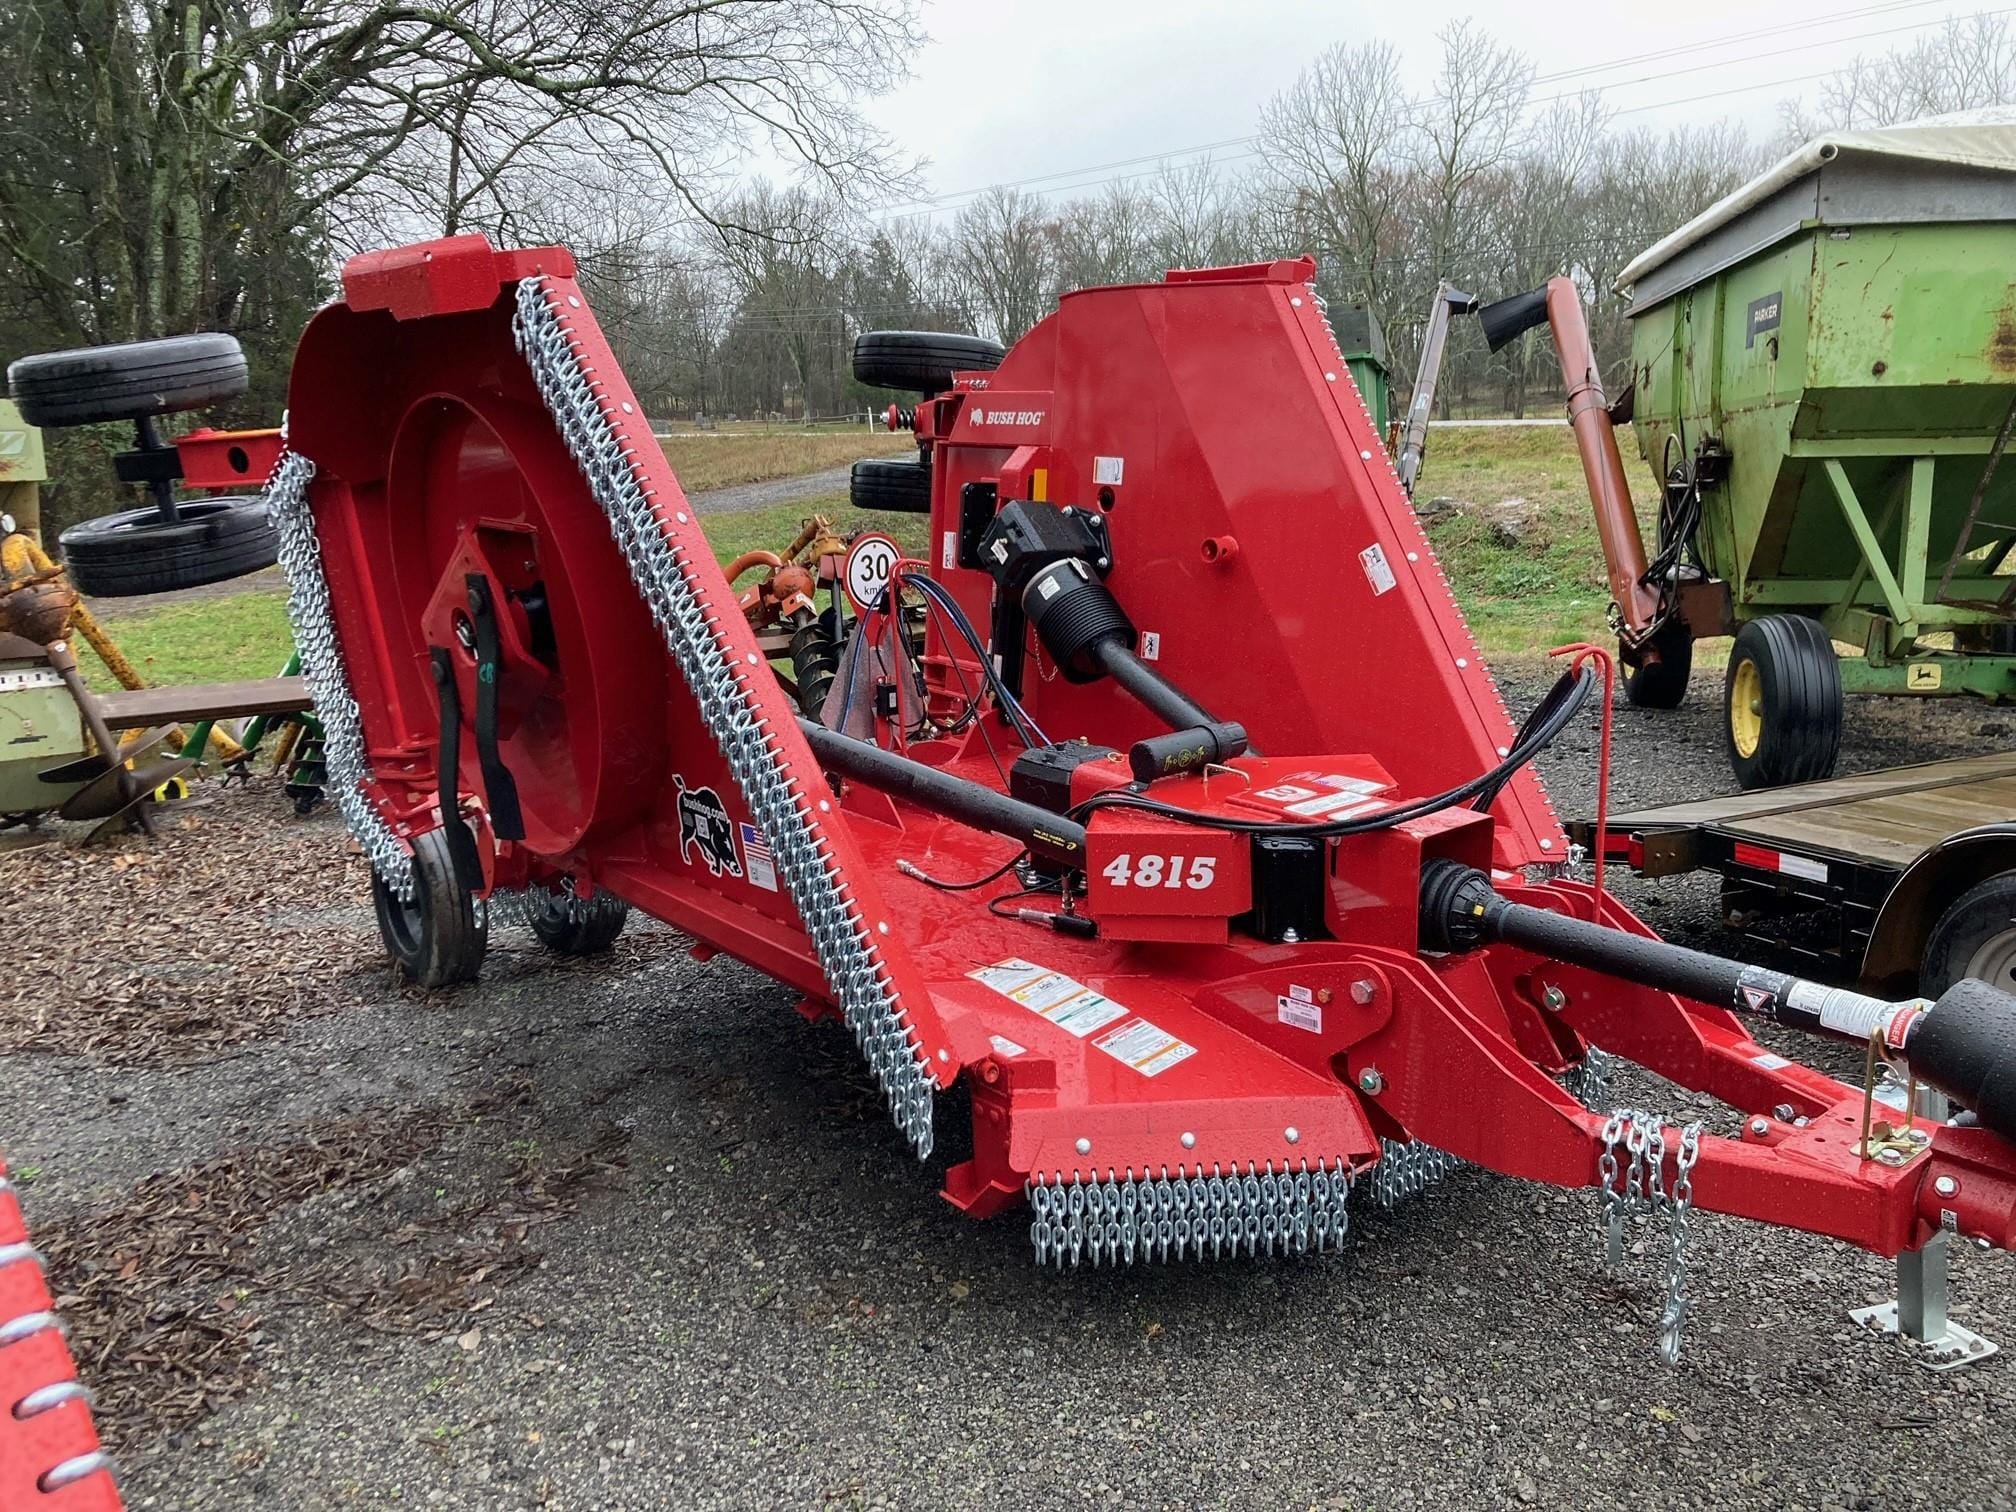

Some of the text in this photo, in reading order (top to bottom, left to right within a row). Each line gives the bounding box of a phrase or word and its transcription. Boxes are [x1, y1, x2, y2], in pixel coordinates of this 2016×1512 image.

[1754, 303, 1778, 324] PARKER
[986, 411, 1016, 425] BUSH
[860, 553, 890, 582] 30
[1102, 854, 1217, 890] 4815
